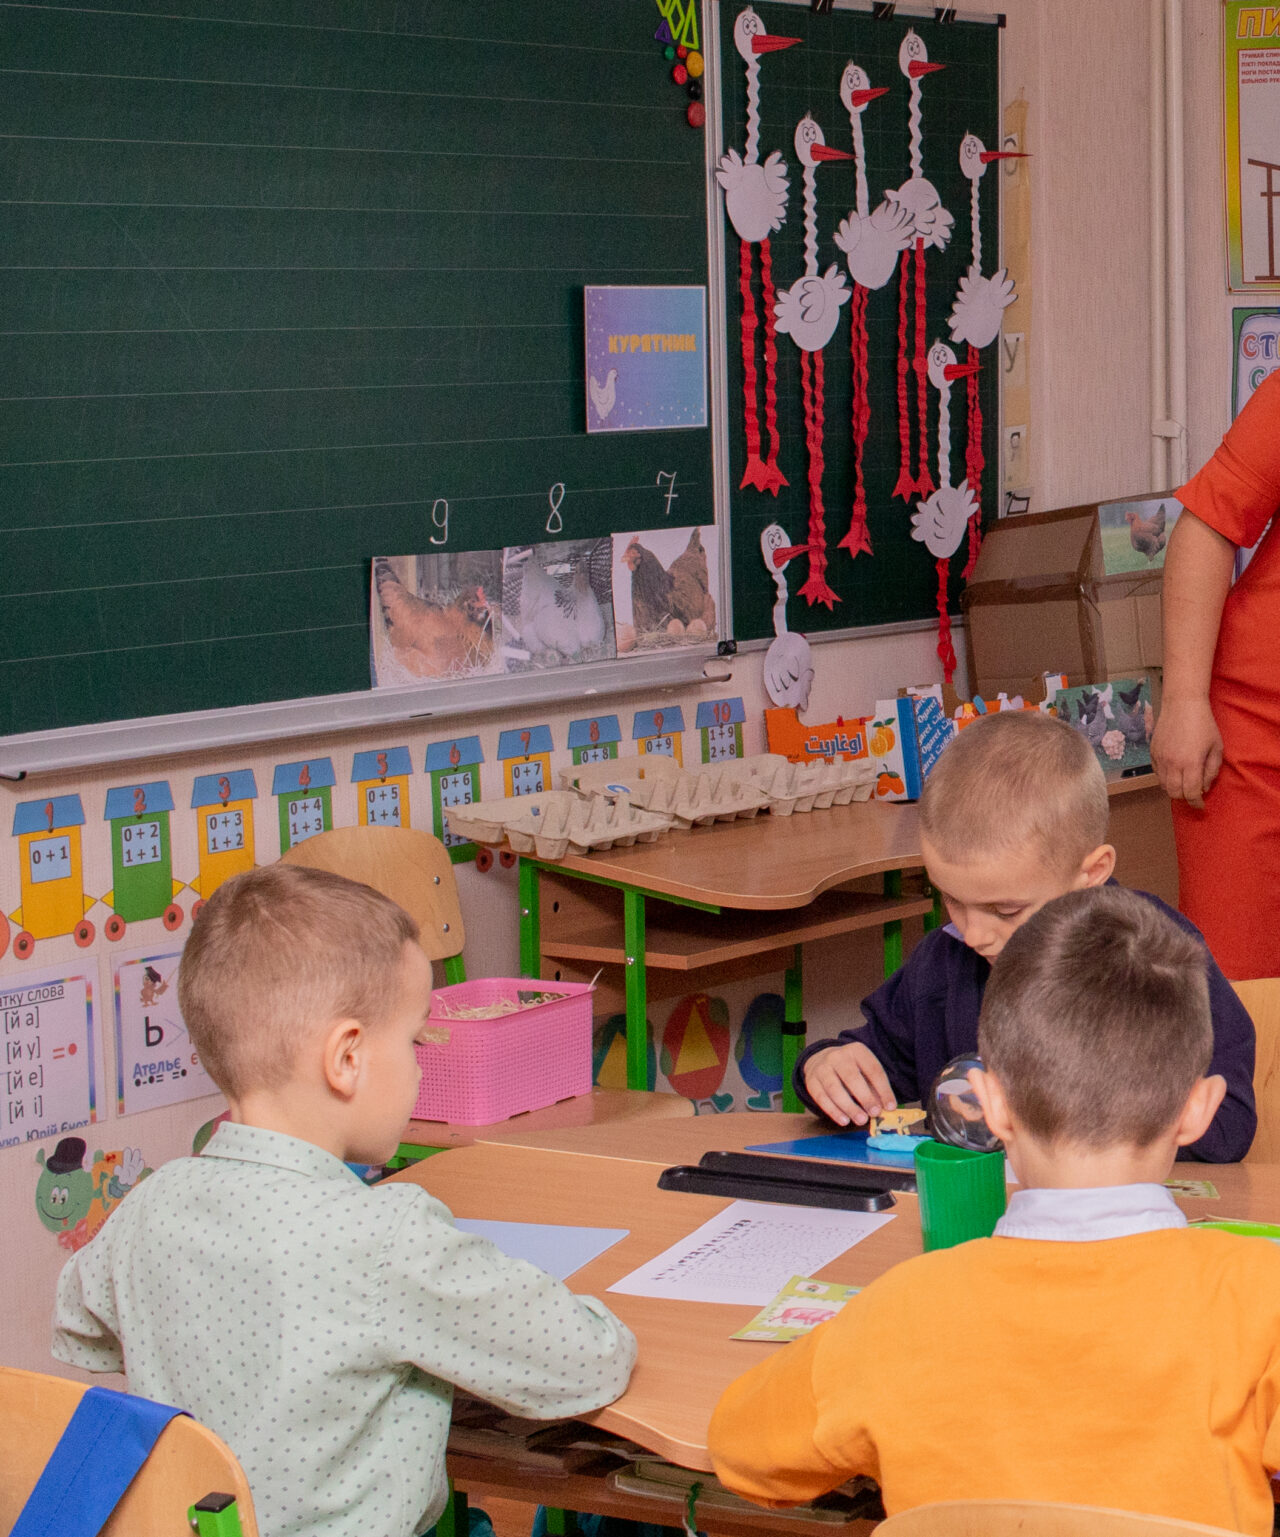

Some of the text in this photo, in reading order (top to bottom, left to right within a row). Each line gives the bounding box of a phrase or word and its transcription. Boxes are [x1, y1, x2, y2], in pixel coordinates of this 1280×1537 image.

[608, 333, 697, 353] КУРЯТНИК
[430, 471, 678, 544] 9 8 7
[713, 702, 731, 723] 10
[654, 711, 664, 733] 9
[590, 721, 599, 742] 8
[710, 730, 716, 740] 1
[727, 726, 734, 737] 9
[520, 731, 530, 752] 7
[646, 741, 653, 753] 0
[665, 737, 672, 749] 9
[710, 746, 717, 757] 2
[728, 744, 735, 755] 8
[805, 732, 863, 757] اوغاريت
[921, 729, 941, 754] Ogaret
[450, 743, 461, 765] 6
[582, 751, 589, 763] 0
[602, 748, 609, 759] 8
[377, 753, 388, 776] 5
[513, 767, 520, 778] 0
[534, 764, 541, 775] 7
[299, 764, 311, 786] 4
[441, 778, 448, 790] 0
[463, 774, 471, 786] 6
[217, 776, 231, 801] 3
[368, 790, 375, 803] 0
[391, 787, 399, 799] 5
[515, 785, 521, 796] 1
[535, 781, 543, 793] 6
[134, 788, 147, 813] 2
[290, 802, 298, 815] 0
[313, 799, 322, 811] 4
[464, 793, 472, 805] 5
[44, 801, 54, 827] 1
[209, 817, 218, 830] 0
[234, 813, 242, 826] 3
[369, 811, 376, 823] 1
[392, 807, 400, 819] 4
[124, 828, 132, 842] 0
[150, 824, 158, 838] 2
[292, 823, 299, 835] 1
[315, 819, 322, 831] 3
[211, 838, 219, 850] 1
[236, 834, 244, 847] 2
[444, 833, 451, 846] 3
[32, 851, 41, 865] 0
[60, 846, 68, 860] 1
[125, 850, 133, 863] 1
[151, 845, 159, 858] 1
[28, 985, 64, 1002] слова
[133, 1057, 181, 1079] Ательє
